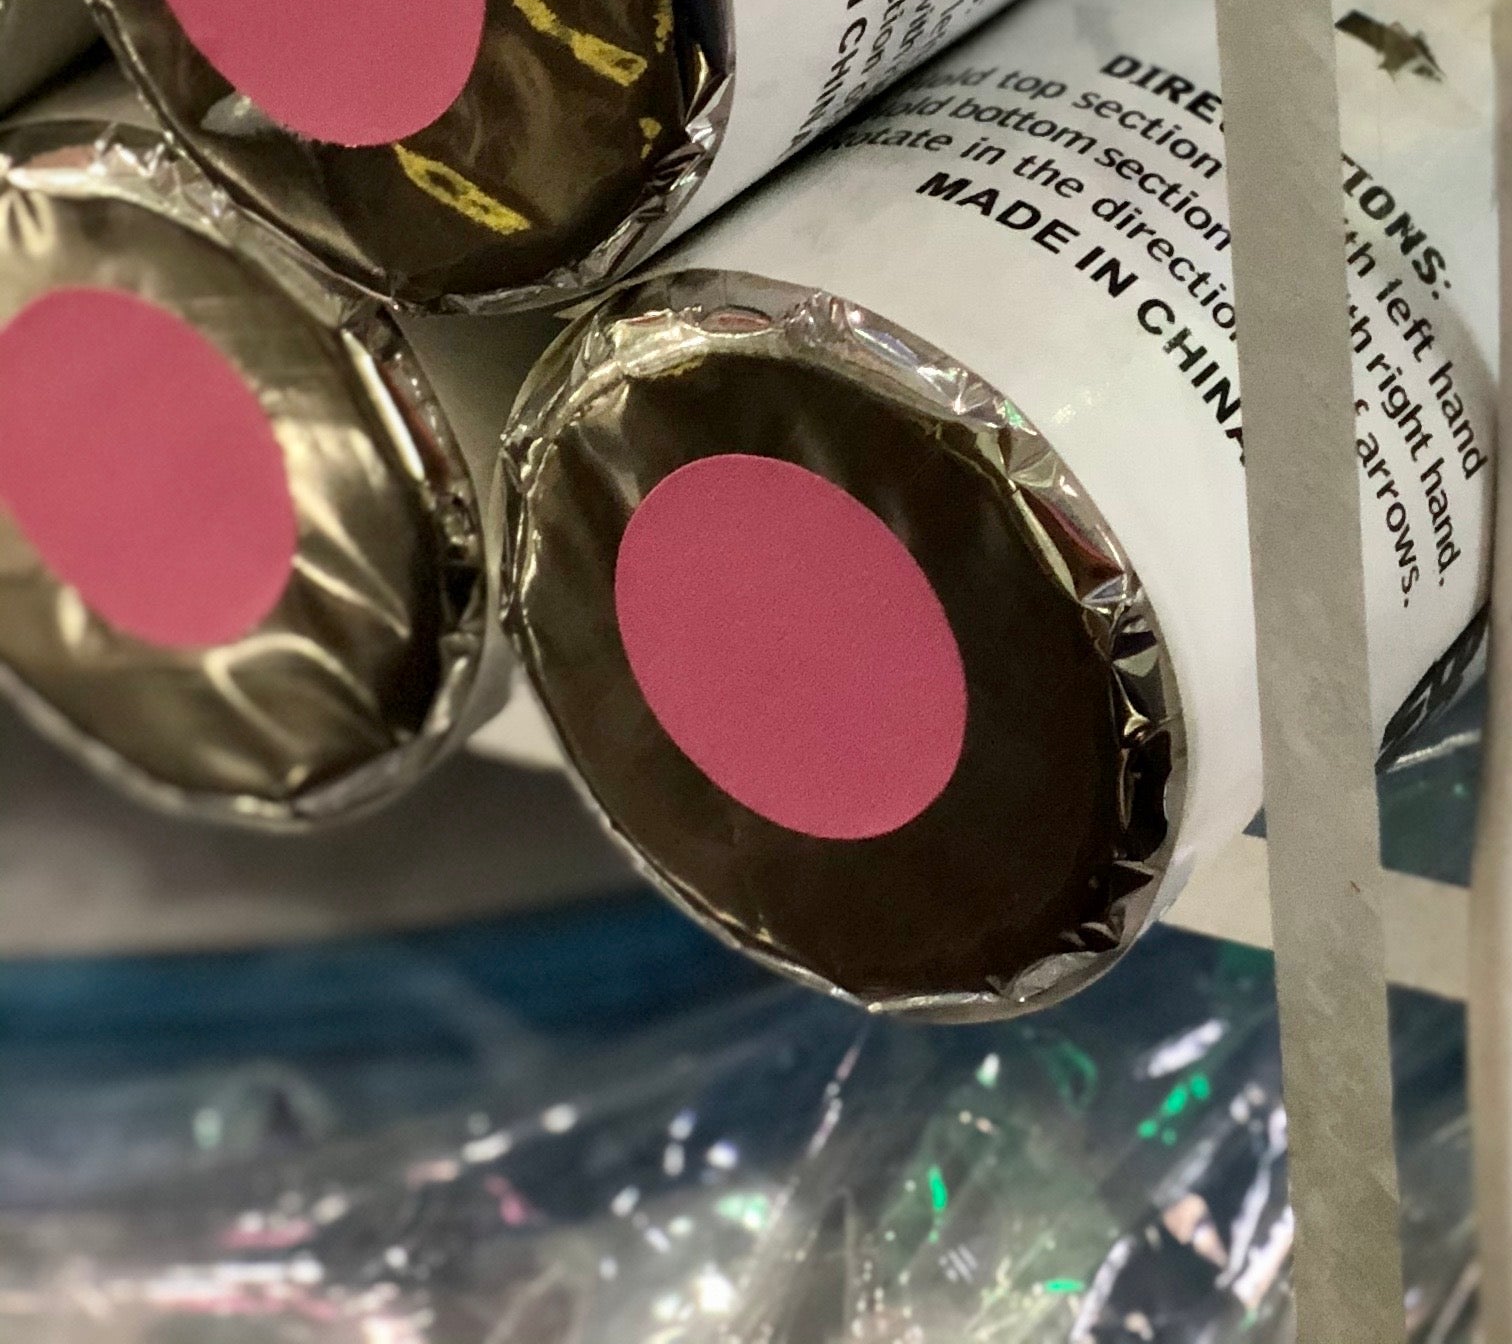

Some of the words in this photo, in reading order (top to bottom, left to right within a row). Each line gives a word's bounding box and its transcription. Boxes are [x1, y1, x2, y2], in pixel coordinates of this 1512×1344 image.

[914, 170, 1082, 255] MADE
[1073, 245, 1140, 299] IN
[948, 96, 1097, 155] bottom
[1094, 144, 1232, 252] section
[1365, 352, 1434, 463] right
[1420, 456, 1462, 587] hand.
[959, 135, 1007, 167] in
[1012, 154, 1085, 199] the
[1090, 197, 1237, 343] directio
[1355, 431, 1420, 609] arrows.
[999, 69, 1068, 100] top
[1070, 90, 1223, 180] section
[1375, 277, 1436, 363] left
[1428, 359, 1489, 481] hand
